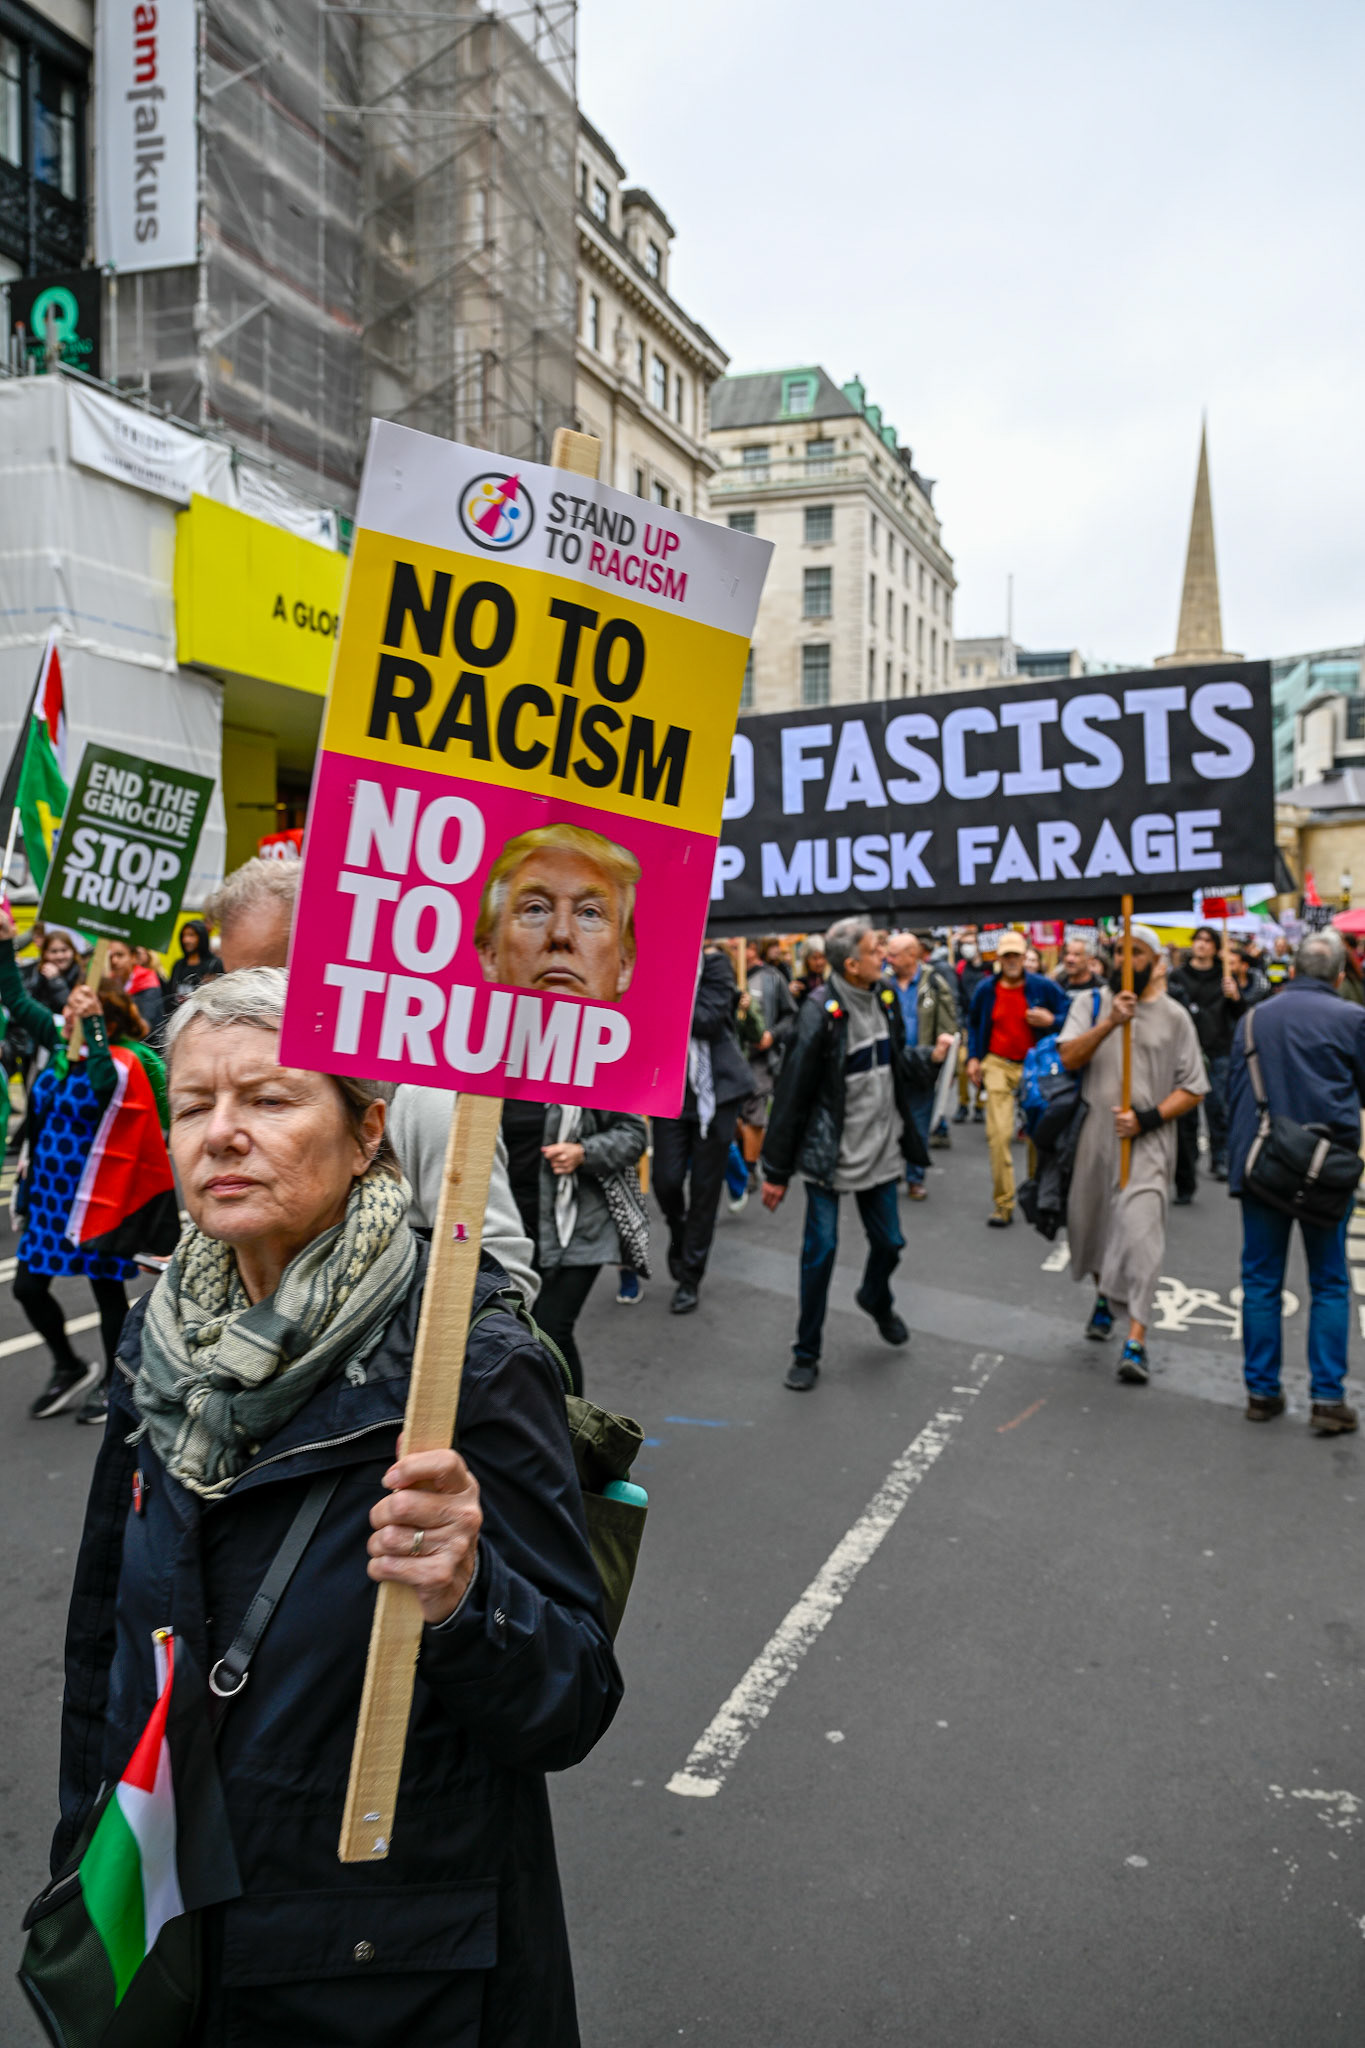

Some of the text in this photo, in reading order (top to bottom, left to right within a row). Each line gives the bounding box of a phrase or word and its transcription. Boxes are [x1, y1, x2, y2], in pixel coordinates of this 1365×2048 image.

[126, 0, 166, 242] amfalkus
[544, 526, 689, 603] TO RACISM
[547, 491, 681, 561] STAND UP
[272, 593, 288, 622] A
[380, 560, 646, 704] NO TO
[366, 651, 693, 808] RACISM
[780, 681, 1255, 816] FASCISTS
[81, 788, 194, 839] GENOCIDE
[86, 760, 200, 817] END THE
[343, 778, 486, 885] NO
[61, 863, 172, 922] TRUMP
[64, 826, 181, 890] STOP
[760, 829, 937, 898] MUSK
[956, 807, 1223, 886] FARAGE
[336, 870, 463, 975] TO
[322, 962, 632, 1088] TRUMP
